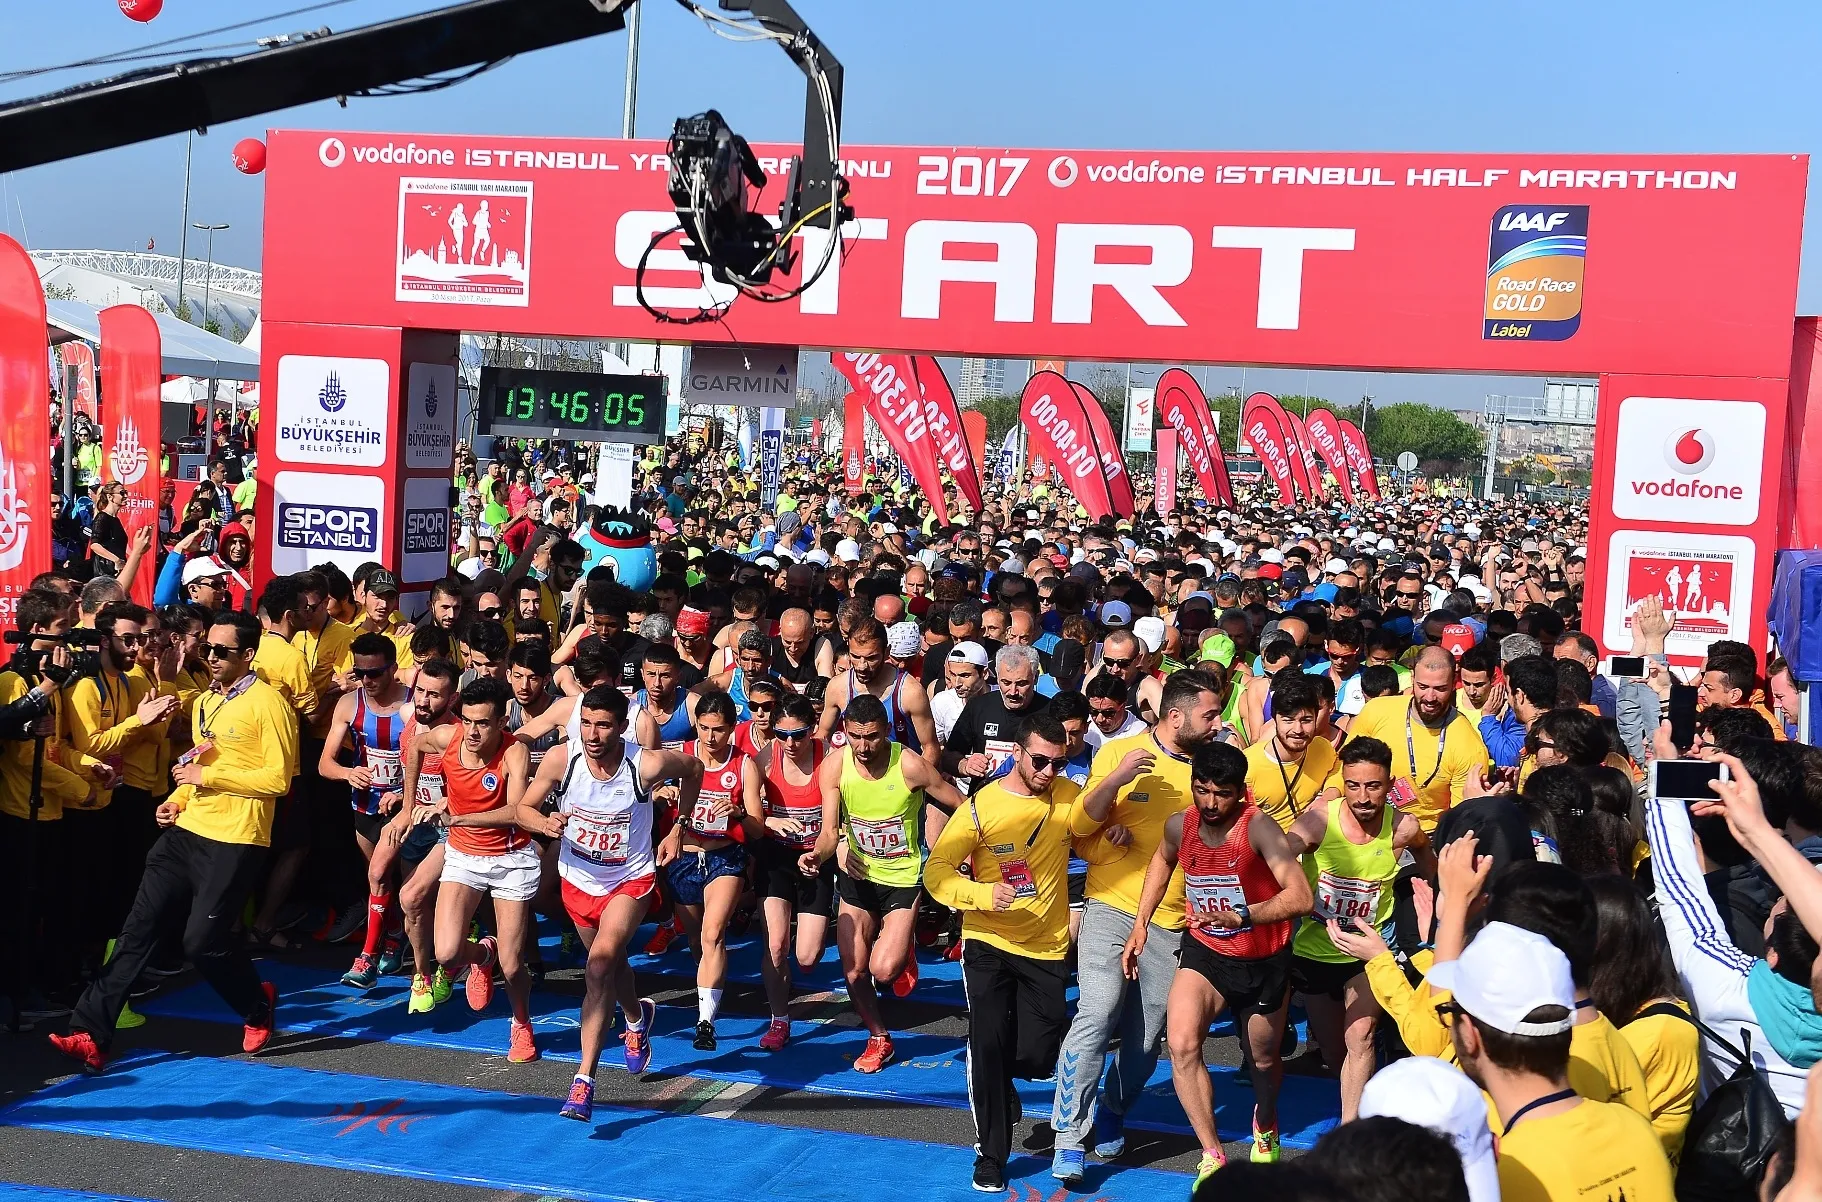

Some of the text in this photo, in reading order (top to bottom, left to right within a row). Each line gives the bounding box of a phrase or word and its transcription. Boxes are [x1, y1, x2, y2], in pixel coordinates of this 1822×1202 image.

[352, 142, 455, 166] vodafone
[916, 155, 1031, 197] 2017
[1086, 159, 1204, 184] vodafone
[1406, 167, 1509, 187] HALF
[1519, 169, 1737, 190] MARATHON
[415, 182, 449, 191] vodafone
[494, 185, 528, 193] MARATONU
[1498, 212, 1570, 232] IAAF
[612, 208, 1356, 331] START
[1496, 276, 1576, 293] Road Race
[1492, 294, 1546, 312] GOLD
[1491, 323, 1532, 338] Label
[691, 373, 790, 394] GARMIN
[505, 387, 645, 426] 13:46:05
[300, 415, 363, 427] İSTANBUL
[281, 424, 381, 447] BÜYÜKŞEHİR
[407, 430, 450, 450] BÜYÜKŞEHİR
[299, 444, 362, 454] BELEDİYESİ
[1631, 478, 1743, 500] vodafone
[284, 507, 372, 534] SPOR
[407, 512, 445, 534] SPOR
[576, 827, 622, 851] 2782
[858, 832, 899, 848] 1179
[1196, 897, 1233, 913] 566
[1323, 895, 1371, 918] 1180
